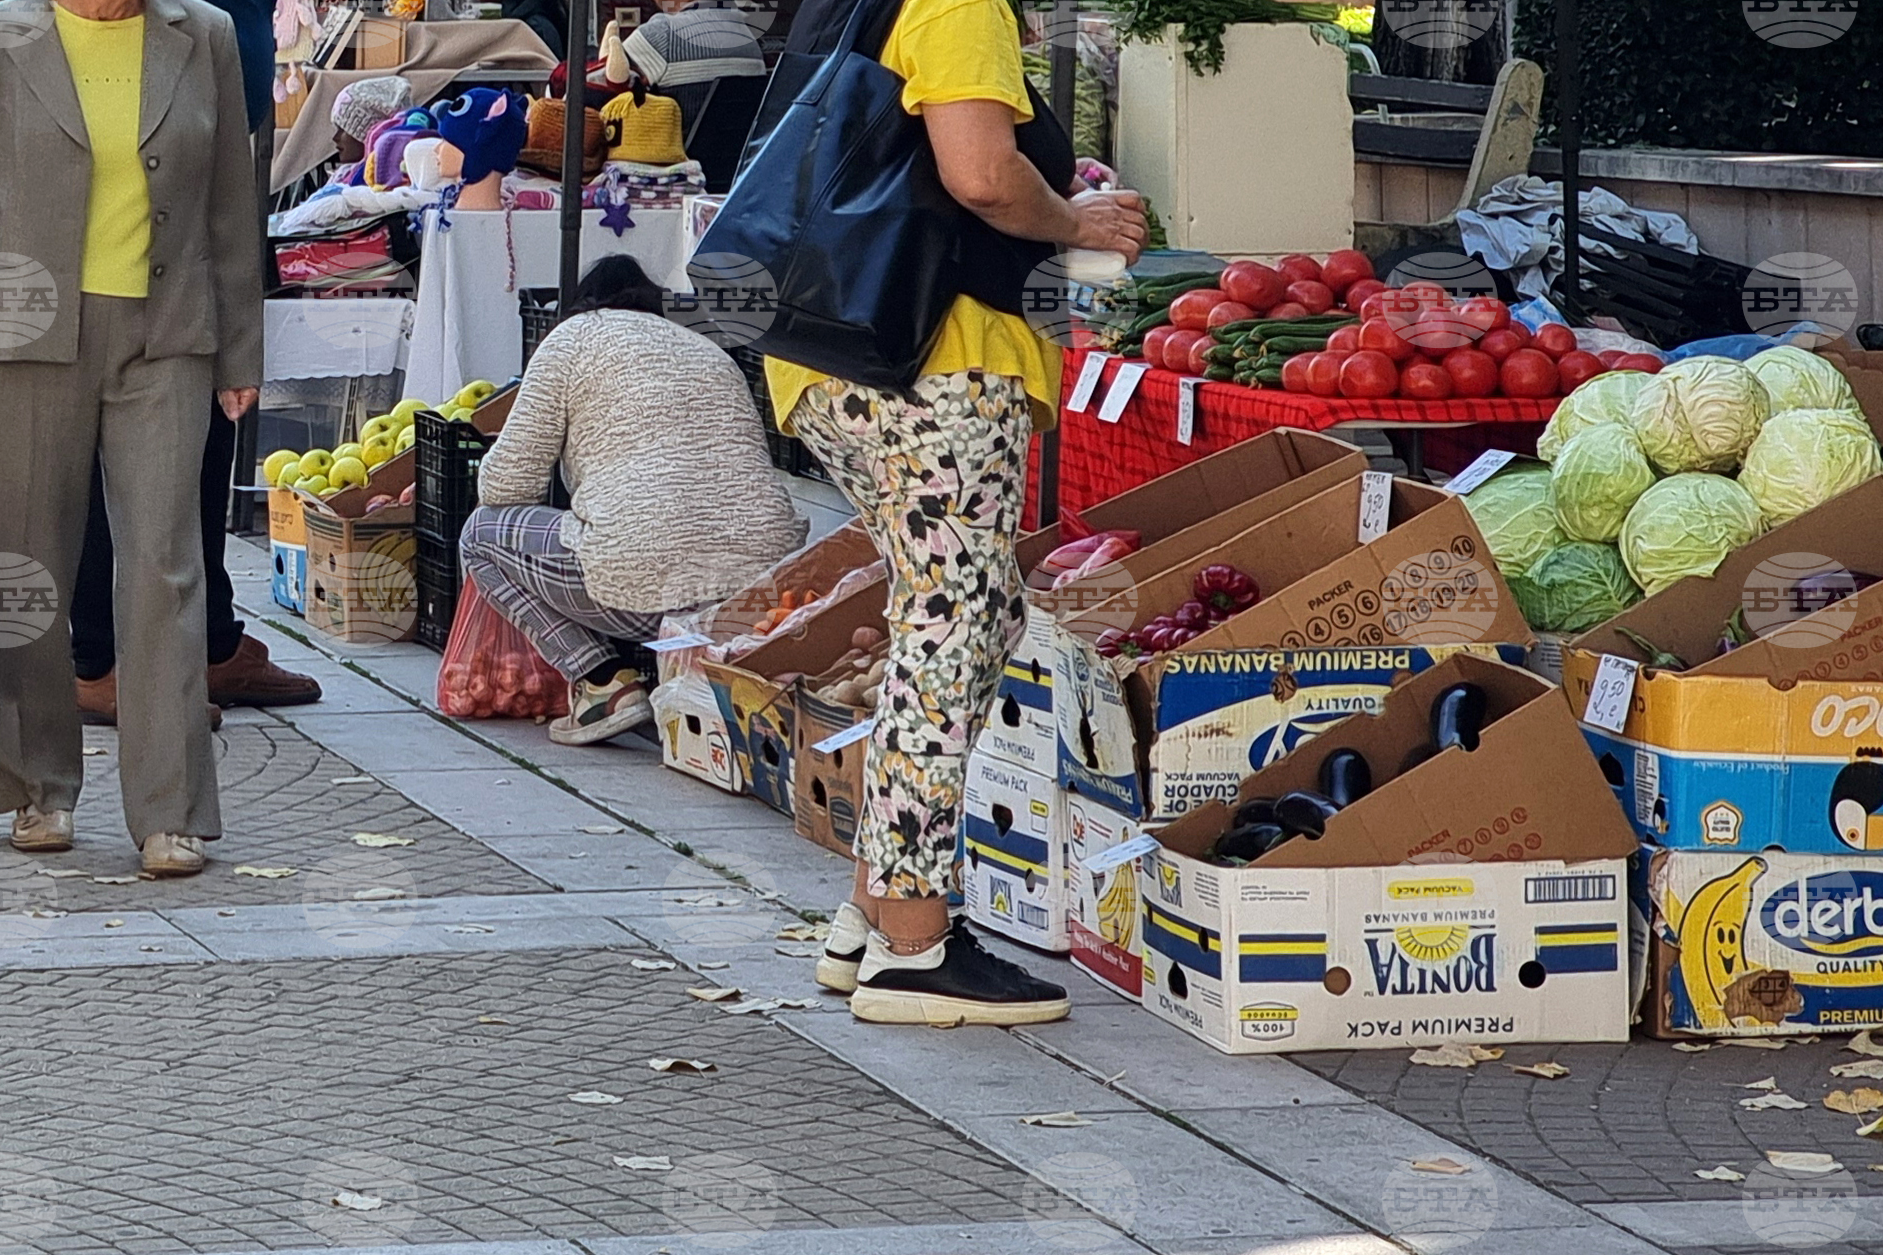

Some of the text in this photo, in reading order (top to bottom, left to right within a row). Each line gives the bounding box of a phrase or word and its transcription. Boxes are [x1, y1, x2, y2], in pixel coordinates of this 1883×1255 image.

[1307, 580, 1354, 611] PACKER
[1164, 648, 1410, 674] PREMIUM BANANAS
[1304, 697, 1376, 712] QUALITY
[1164, 772, 1240, 782] VACUUM PACK
[1163, 800, 1187, 813] OF
[1396, 885, 1464, 896] VACUUM PACK
[1365, 909, 1496, 925] PREMIUM BANANAS
[1365, 933, 1497, 996] BONITA
[1250, 1022, 1284, 1033] 100%
[1347, 1016, 1514, 1039] PREMIUM PACK
